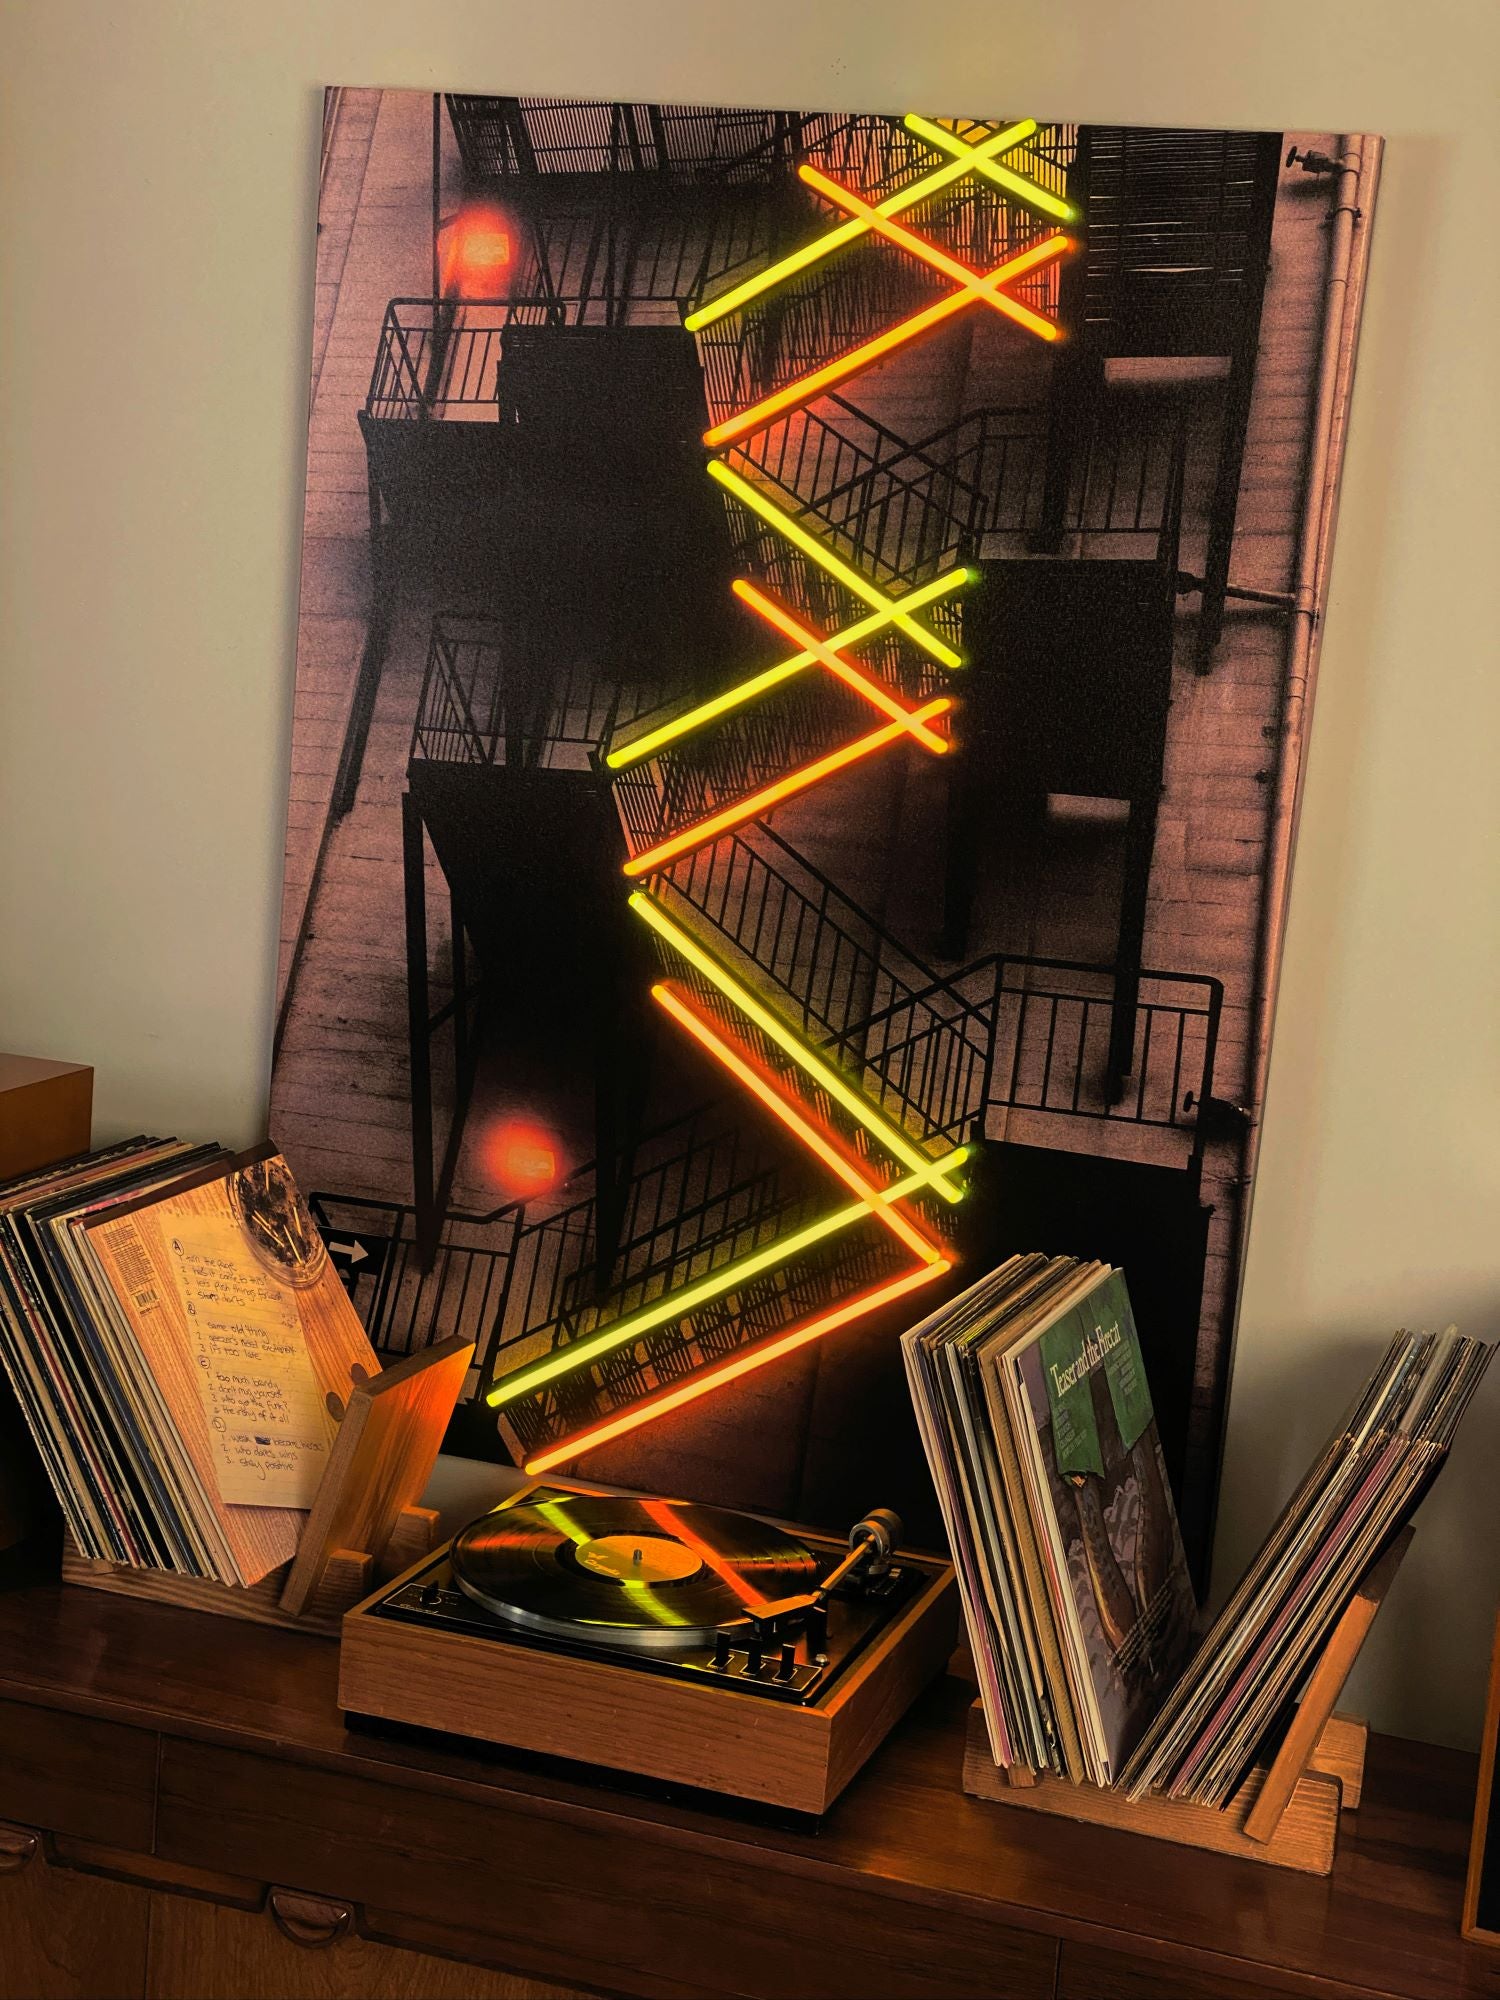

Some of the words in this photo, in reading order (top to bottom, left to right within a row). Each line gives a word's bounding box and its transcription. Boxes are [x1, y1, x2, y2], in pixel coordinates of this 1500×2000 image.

[1050, 1363, 1078, 1398] Teaser
[1075, 1339, 1090, 1379] and
[1086, 1335, 1101, 1367] the
[1095, 1320, 1122, 1358] Firecat
